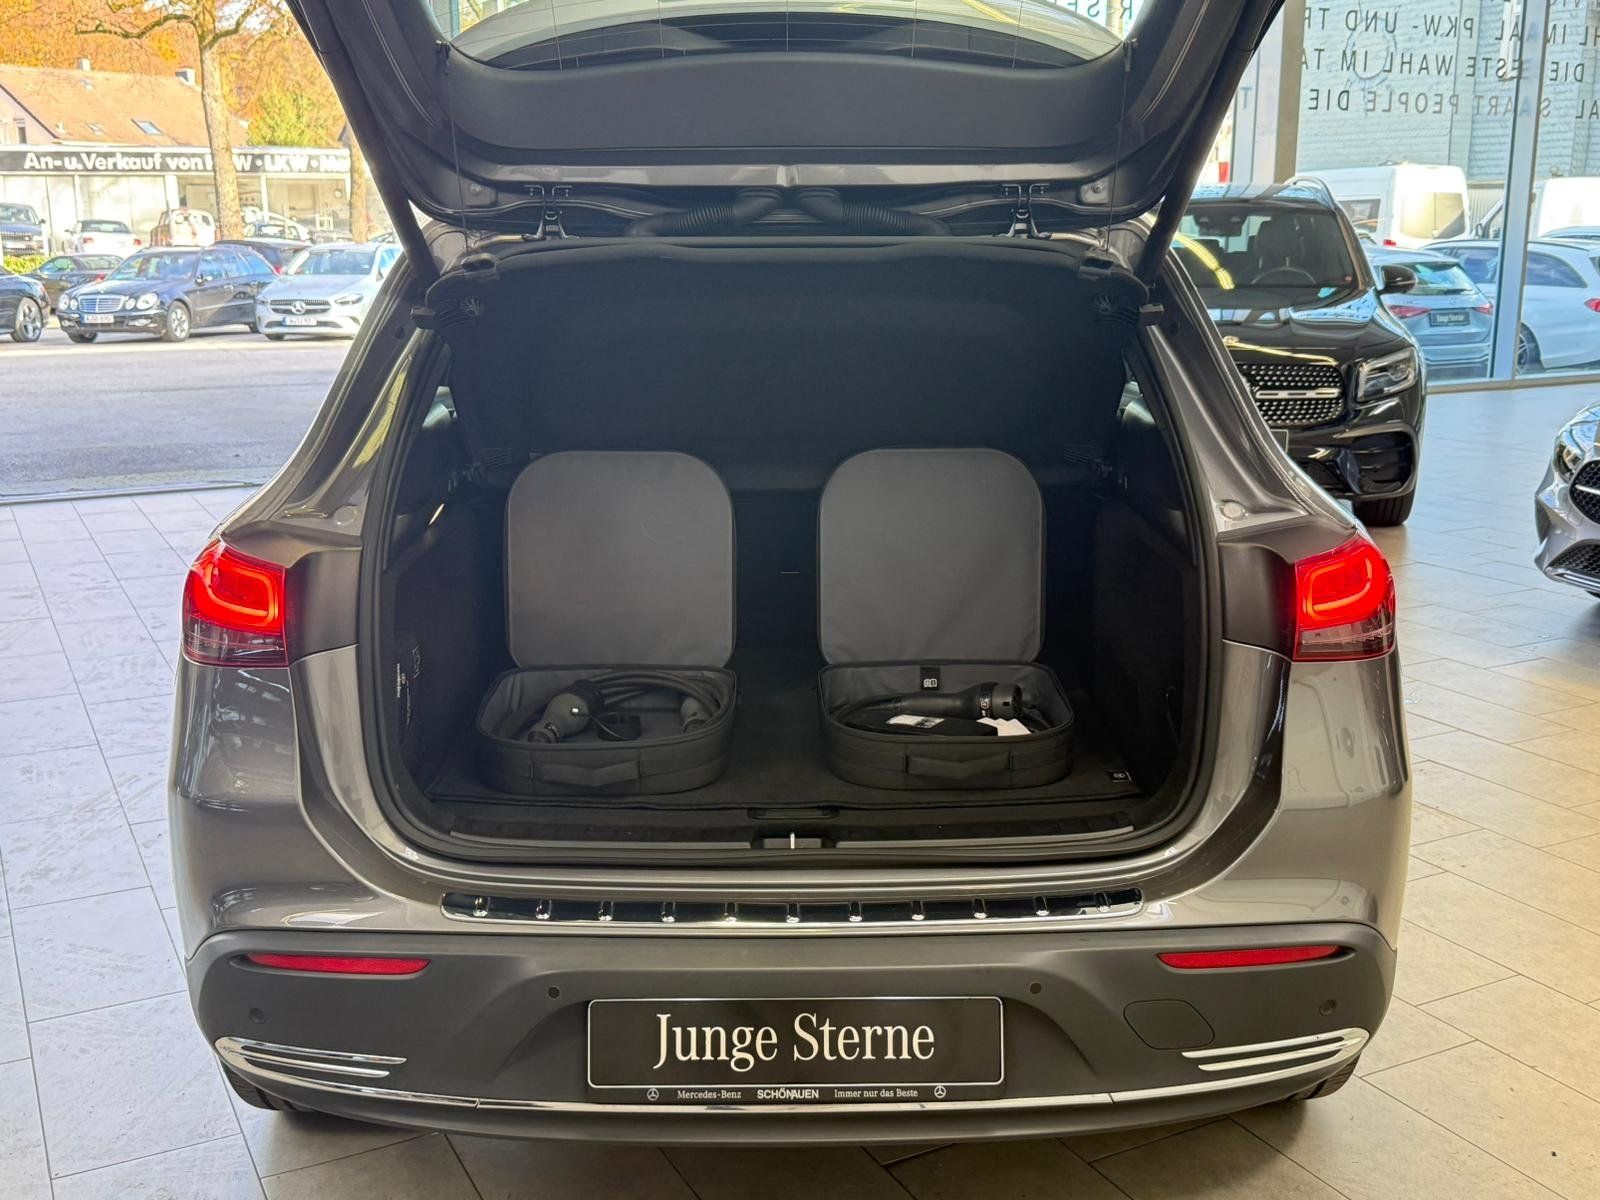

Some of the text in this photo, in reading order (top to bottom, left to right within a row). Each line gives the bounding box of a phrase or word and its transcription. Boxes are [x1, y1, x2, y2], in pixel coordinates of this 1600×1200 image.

[166, 155, 204, 170] von
[653, 1012, 935, 1072] Junge Sterne
[677, 1087, 918, 1100] Mercedes-Benz SCHÖNAUEN Immer nur das Beste
